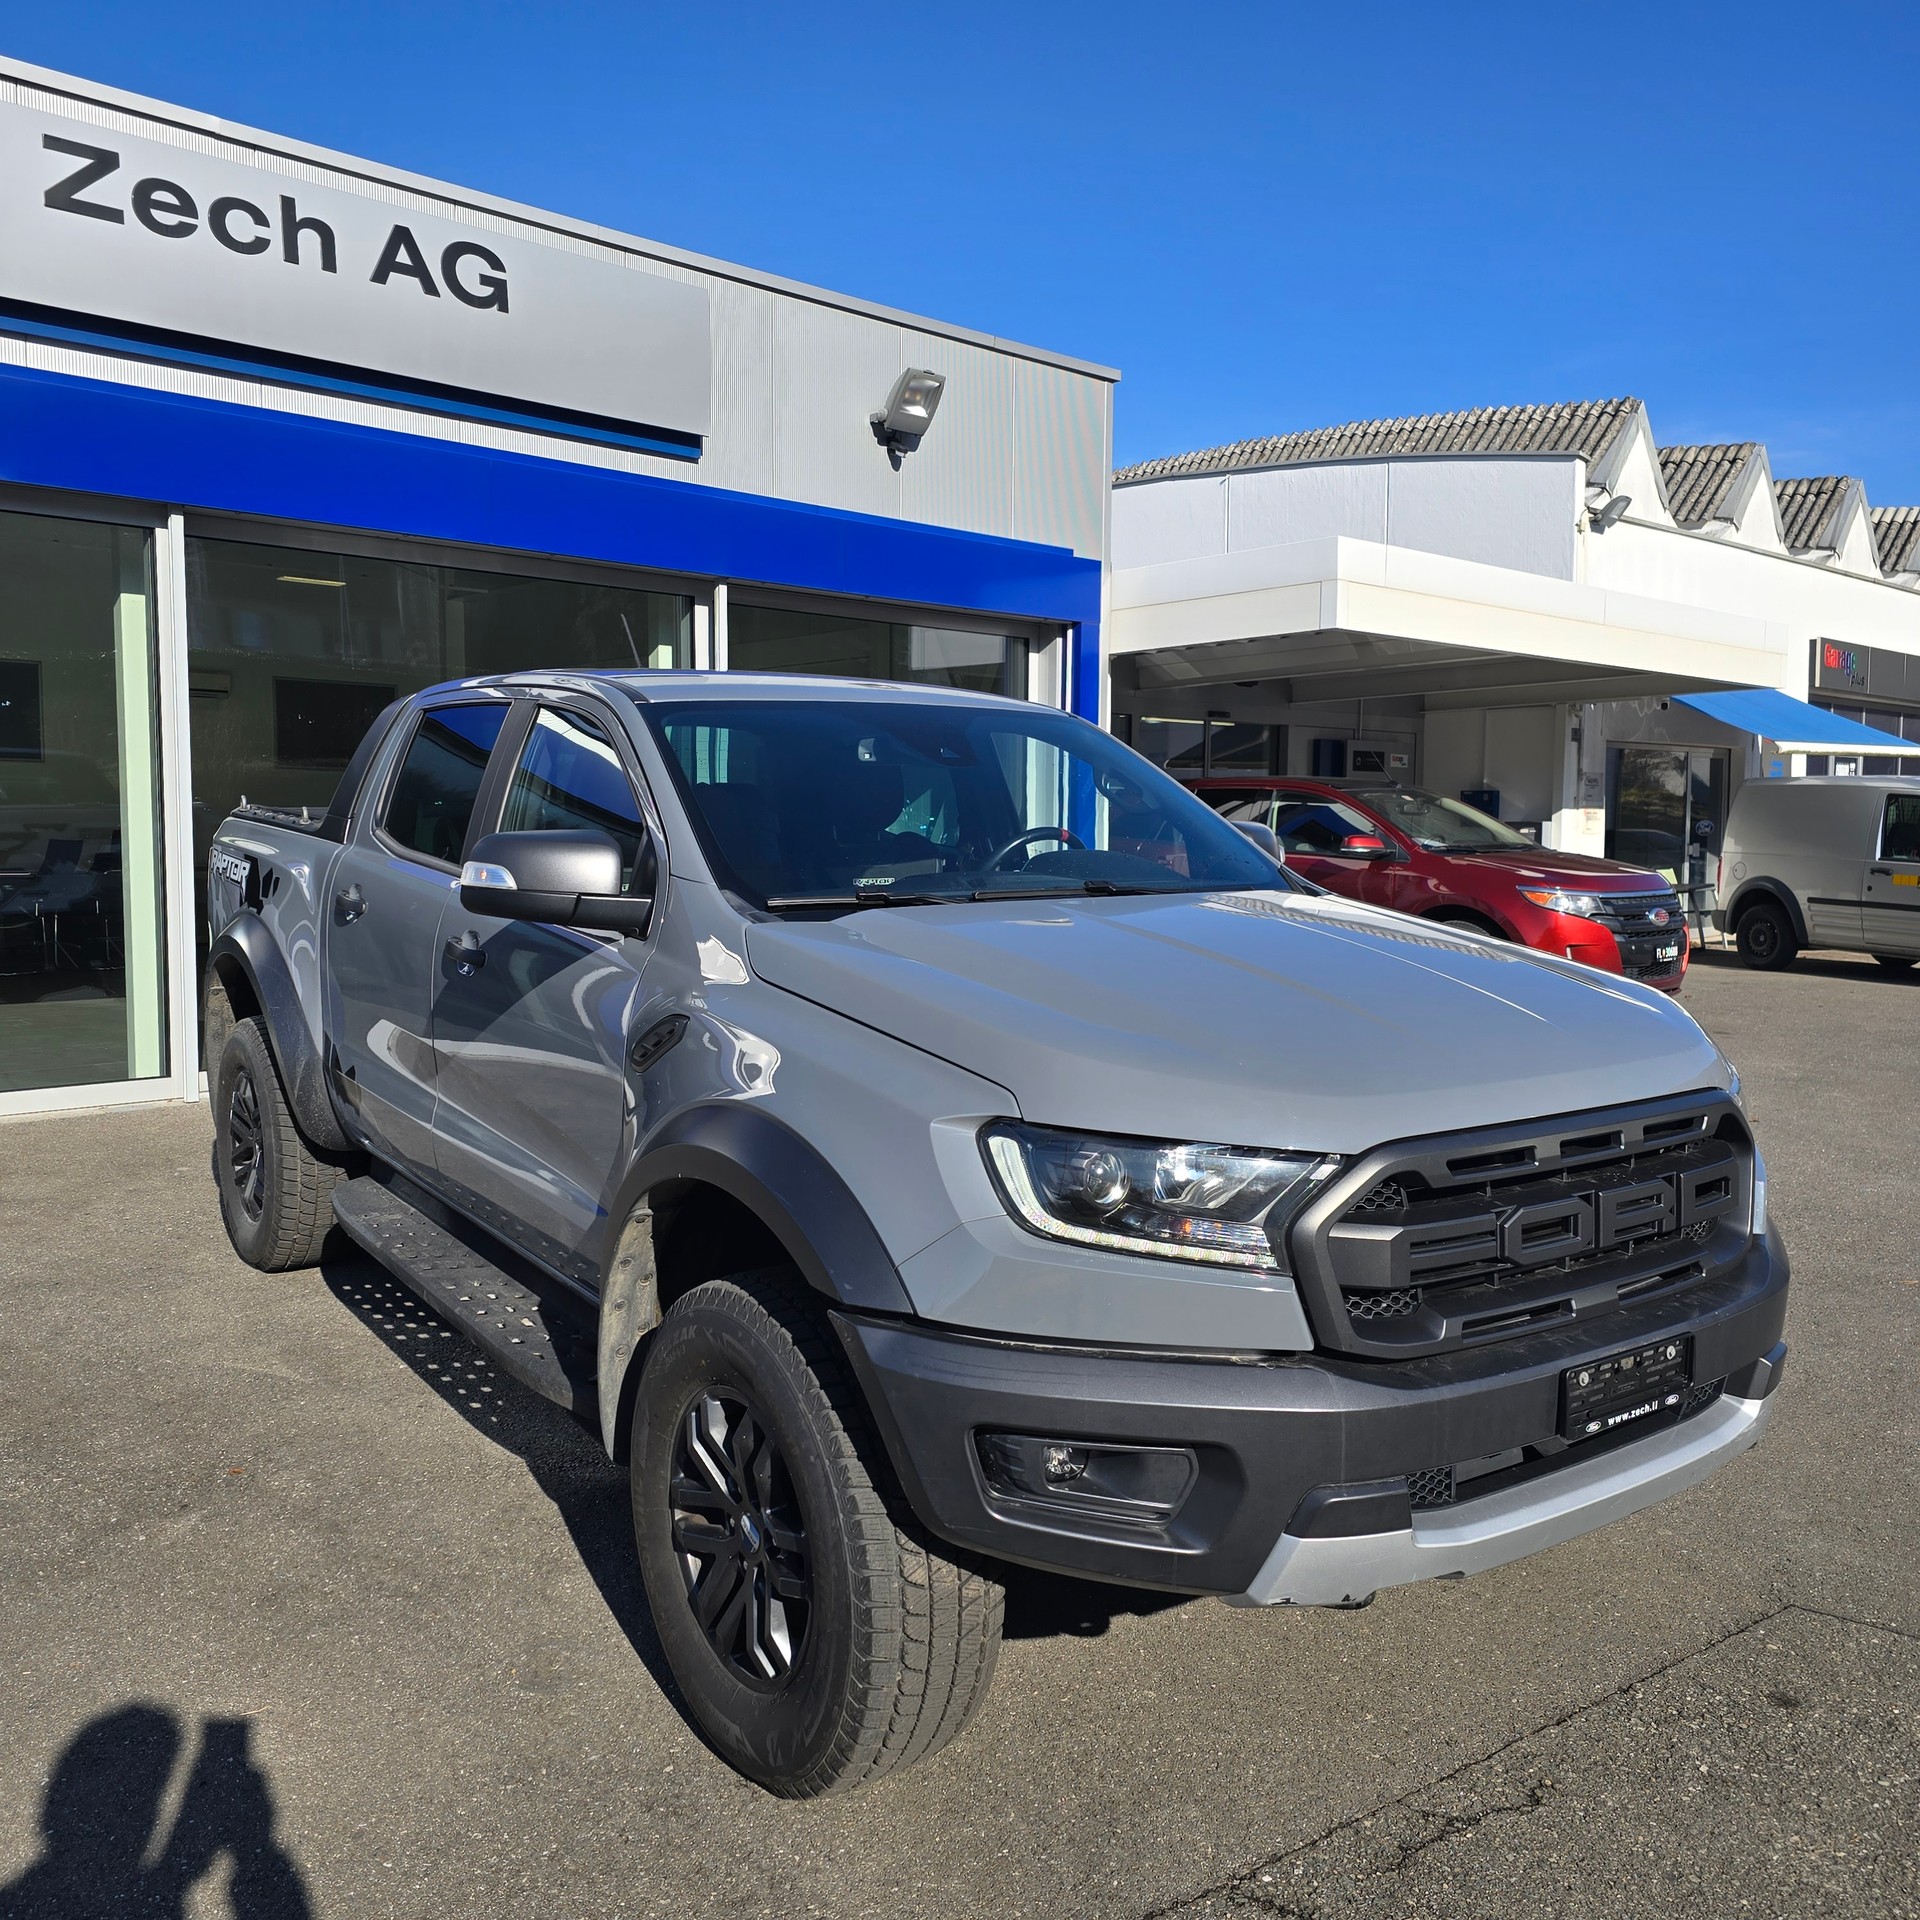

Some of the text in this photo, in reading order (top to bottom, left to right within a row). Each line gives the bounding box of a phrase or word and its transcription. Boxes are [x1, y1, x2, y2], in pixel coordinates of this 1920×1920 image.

[42, 133, 510, 314] Zech AG
[1825, 643, 1857, 678] Garage
[210, 848, 251, 888] RAPTOR
[1328, 1157, 1740, 1289] FORD
